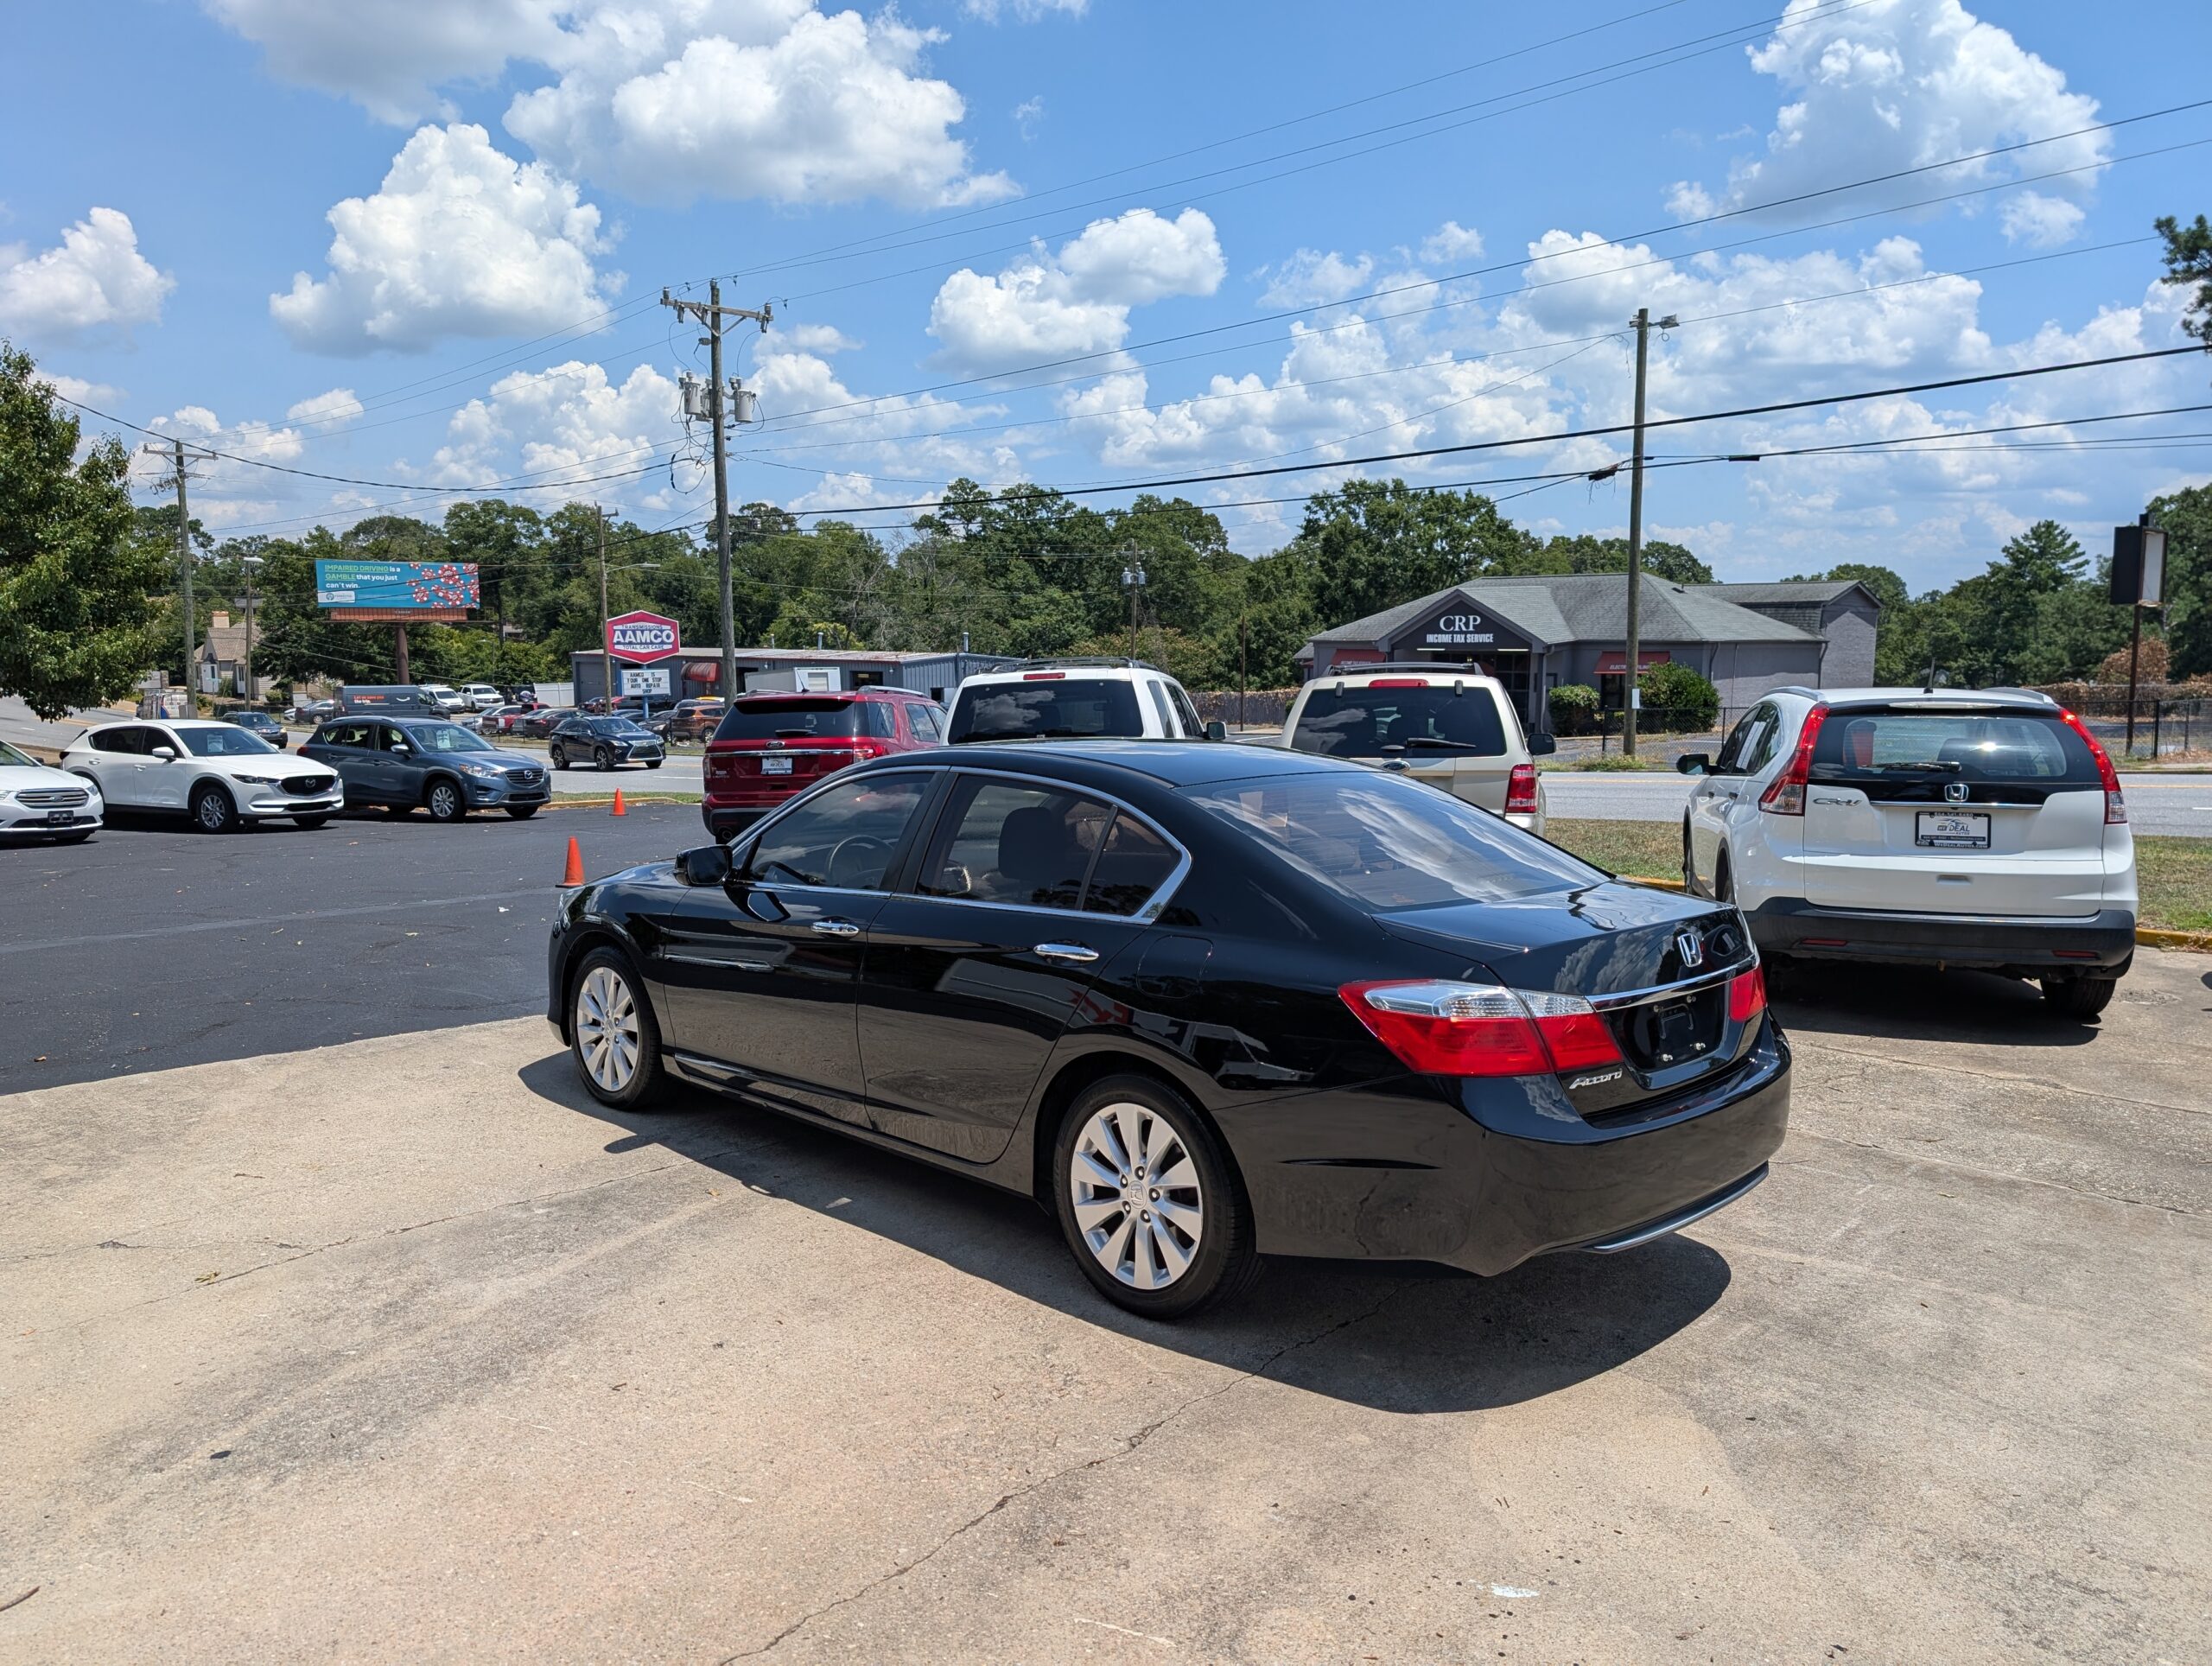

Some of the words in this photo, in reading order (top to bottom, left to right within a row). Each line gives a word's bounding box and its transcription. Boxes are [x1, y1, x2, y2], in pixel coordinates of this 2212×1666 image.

[1440, 615, 1481, 632] CRP
[613, 630, 675, 643] AAMCO
[1427, 633, 1452, 643] INCOME
[1453, 633, 1465, 643] TAX
[1466, 633, 1493, 643] SERVICE
[1569, 1068, 1623, 1089] Accord
